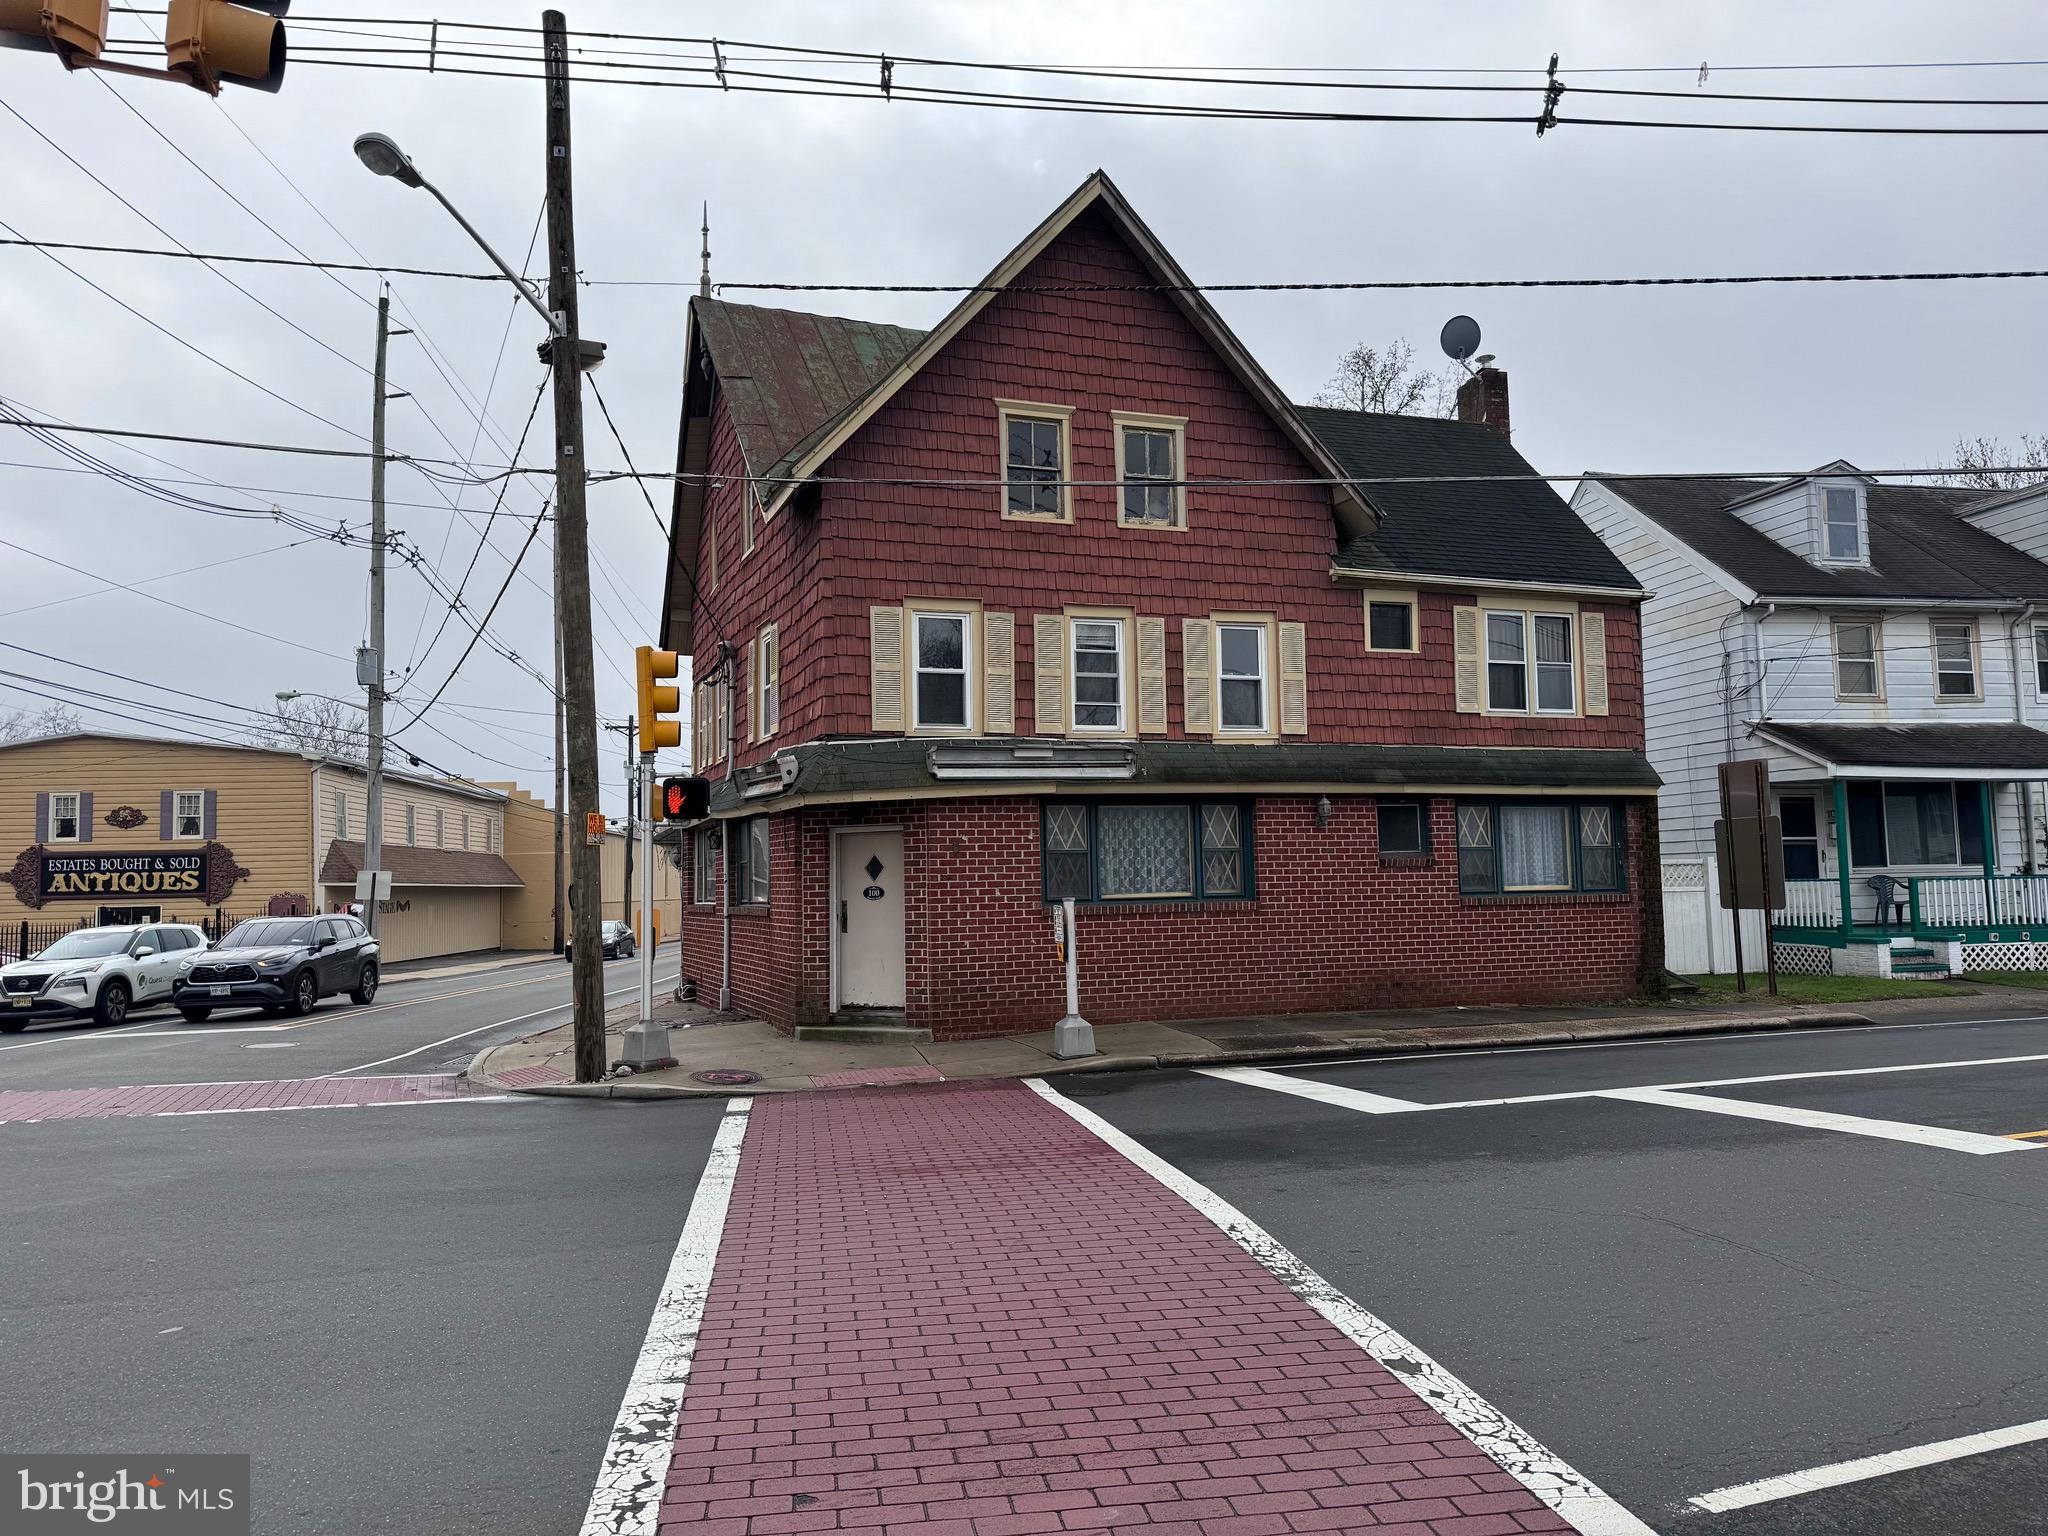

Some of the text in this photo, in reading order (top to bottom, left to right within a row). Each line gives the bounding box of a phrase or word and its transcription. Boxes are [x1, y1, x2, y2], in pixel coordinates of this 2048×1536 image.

[49, 857, 200, 871] ESTATES BOUGHT & SOLD
[48, 871, 200, 892] ANTIQUES
